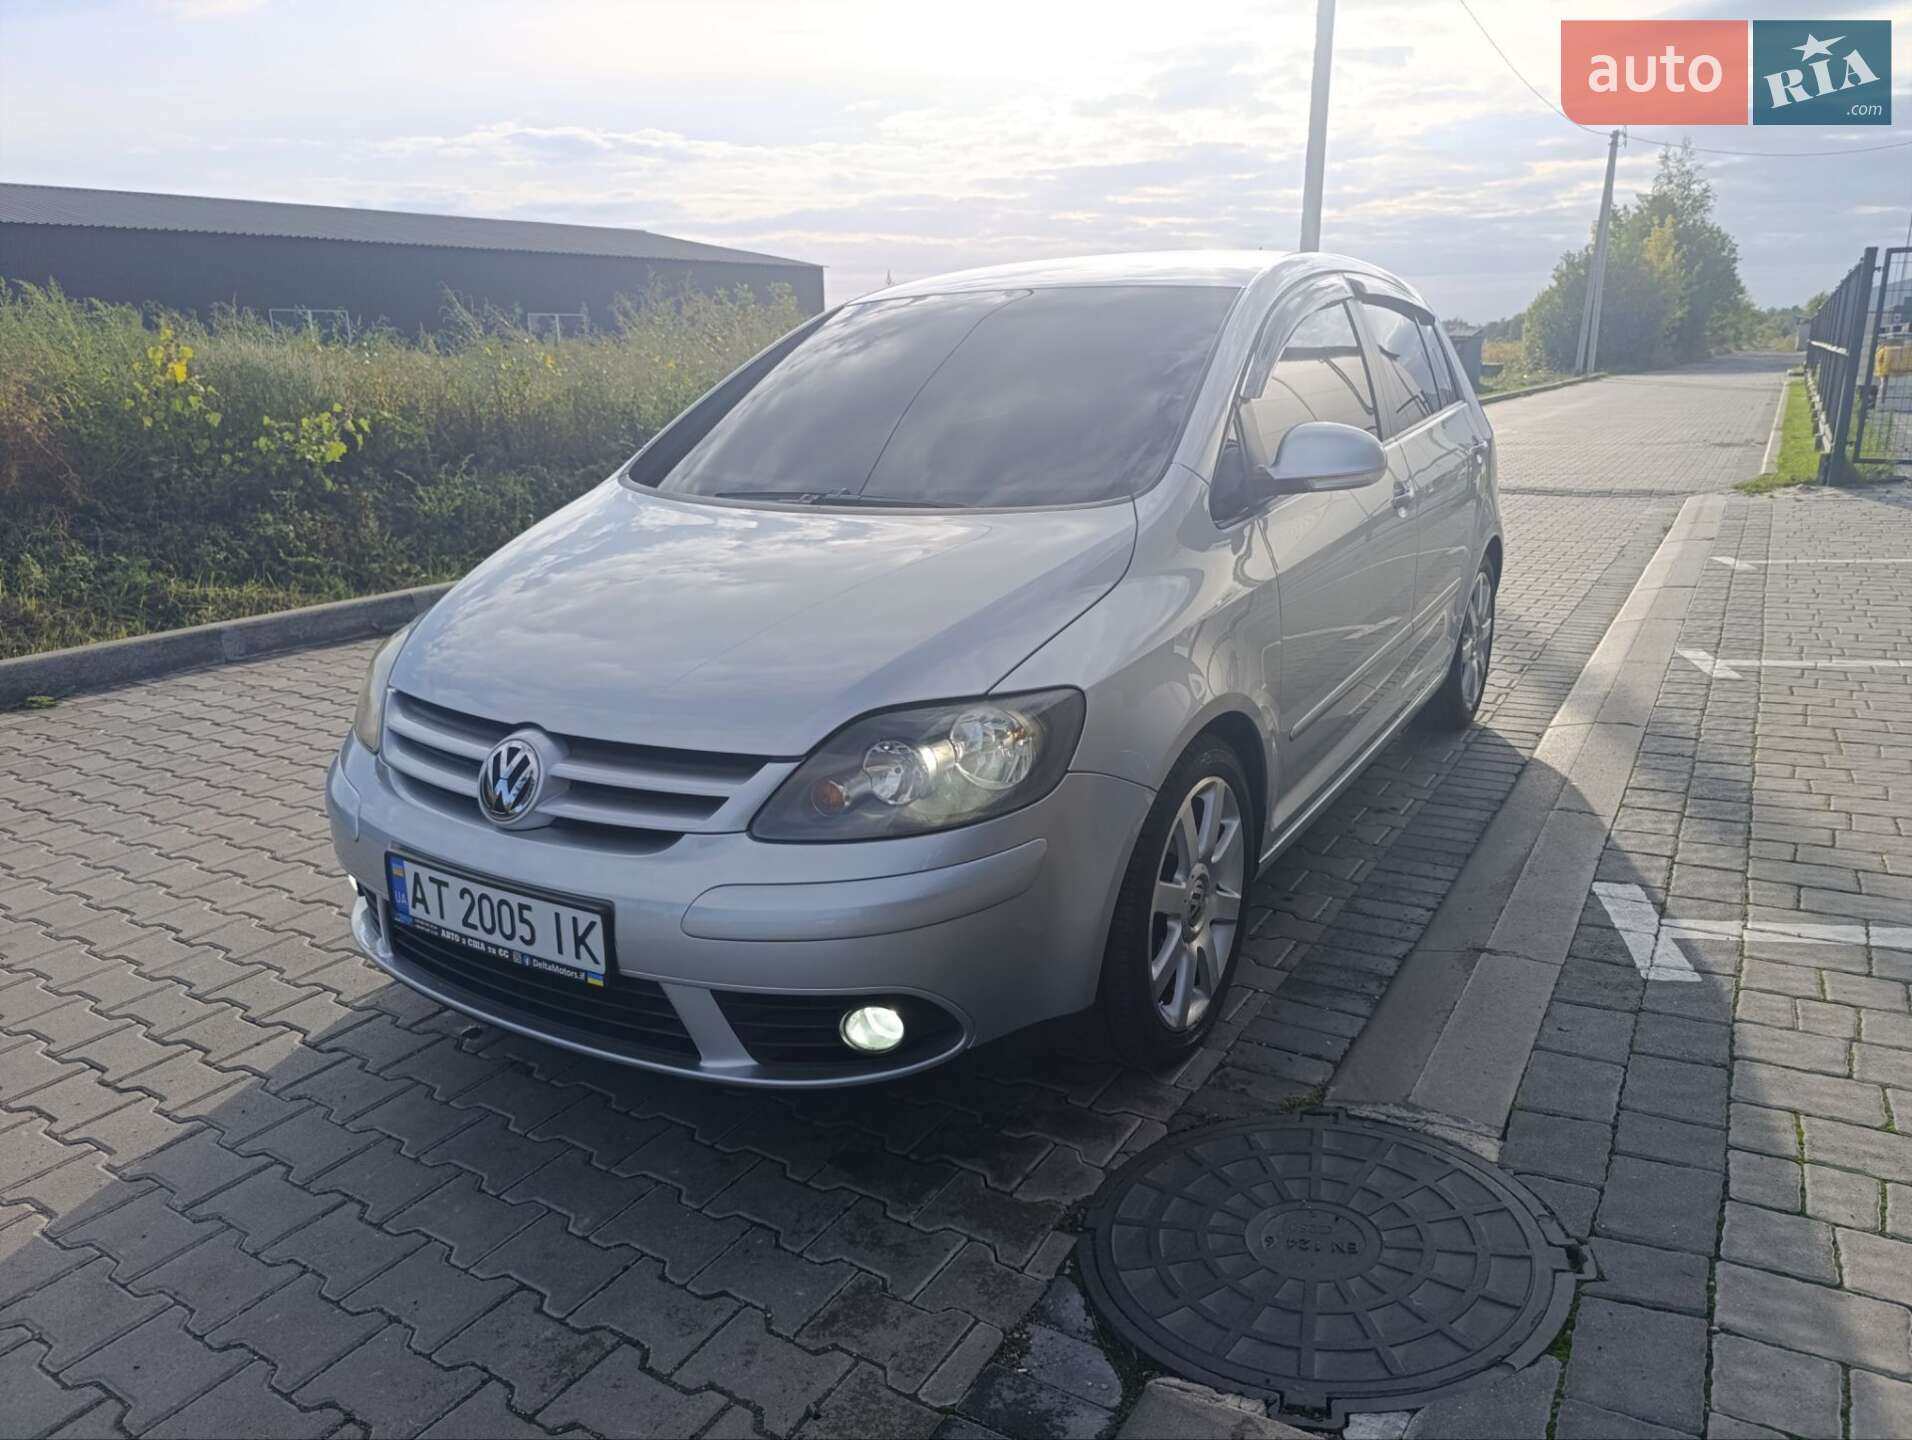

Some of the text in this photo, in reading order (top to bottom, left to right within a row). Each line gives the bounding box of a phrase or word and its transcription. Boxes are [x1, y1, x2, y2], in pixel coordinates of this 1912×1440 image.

[394, 888, 408, 905] UA
[411, 871, 600, 965] AT 2005 IK
